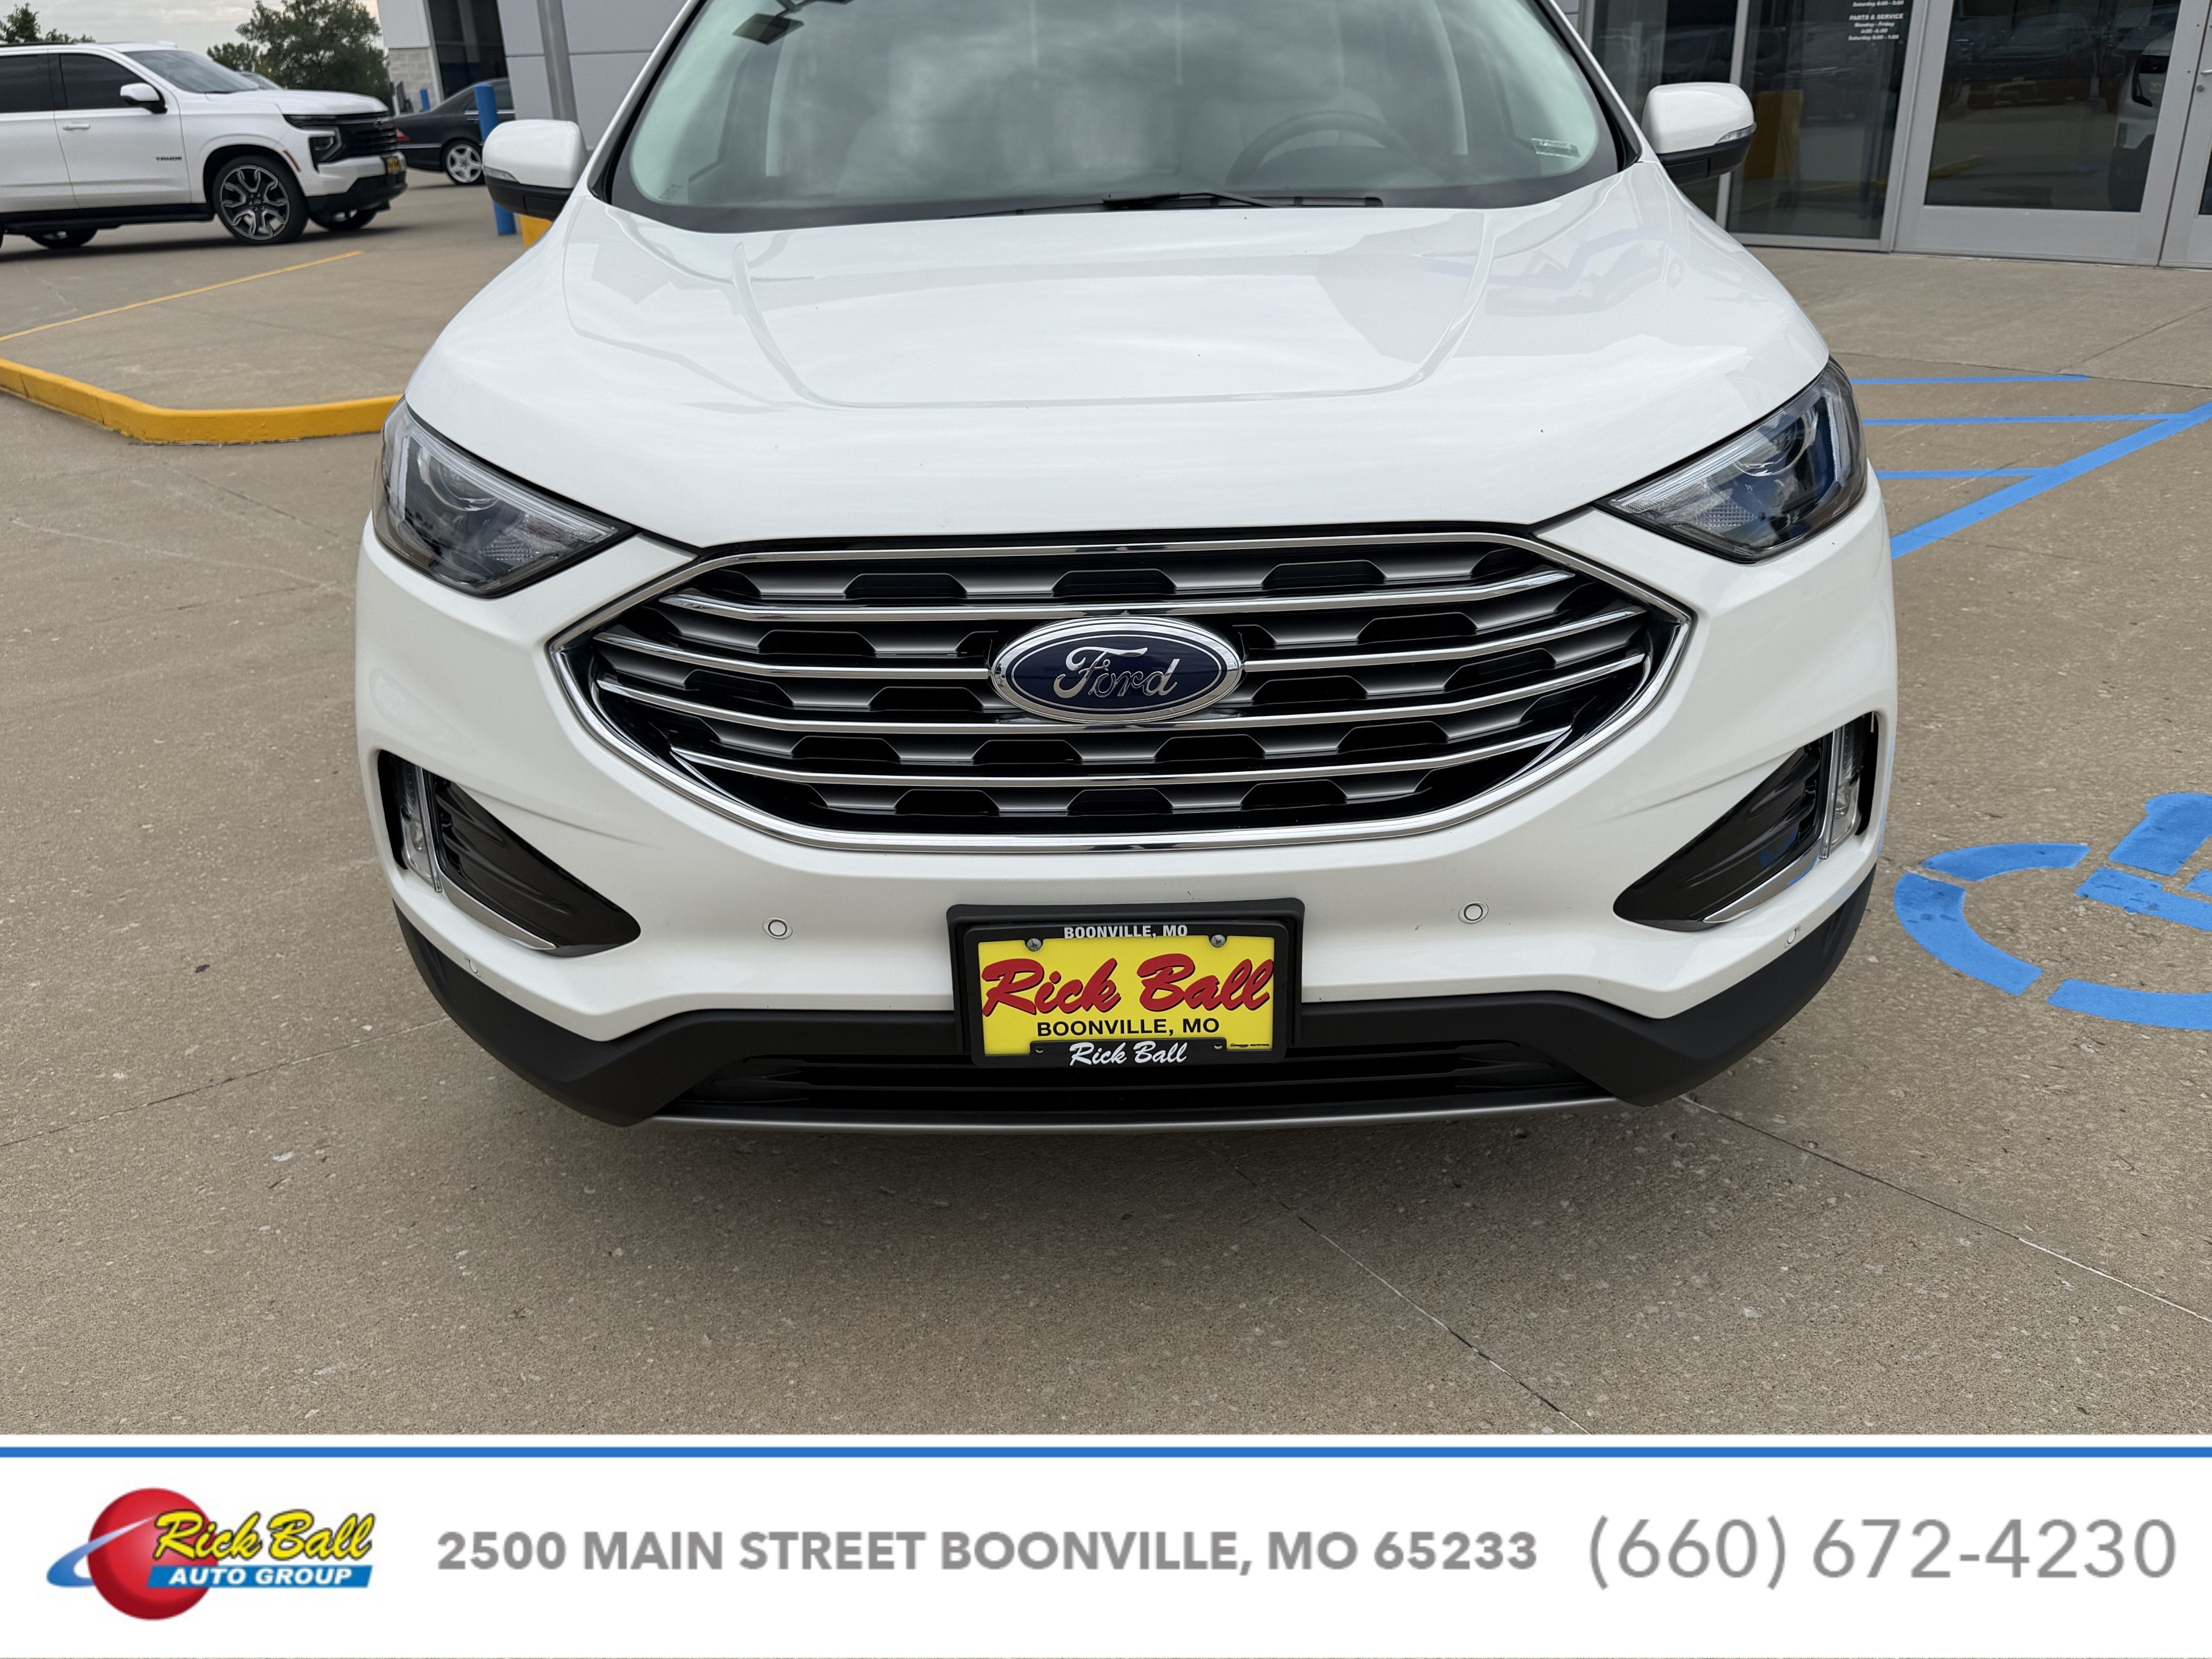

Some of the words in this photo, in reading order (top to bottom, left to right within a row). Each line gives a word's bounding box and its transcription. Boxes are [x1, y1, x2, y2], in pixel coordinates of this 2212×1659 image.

[1053, 646, 1180, 698] Ford
[1064, 926, 1156, 939] BOONVILLE,
[1163, 925, 1187, 936] MO
[981, 958, 1121, 1016] Rick
[1137, 953, 1274, 1013] Ball
[1037, 1018, 1173, 1036] BOONVILLE,
[1183, 1018, 1219, 1033] MO
[1070, 1042, 1127, 1066] Rick
[1133, 1041, 1187, 1063] Ball
